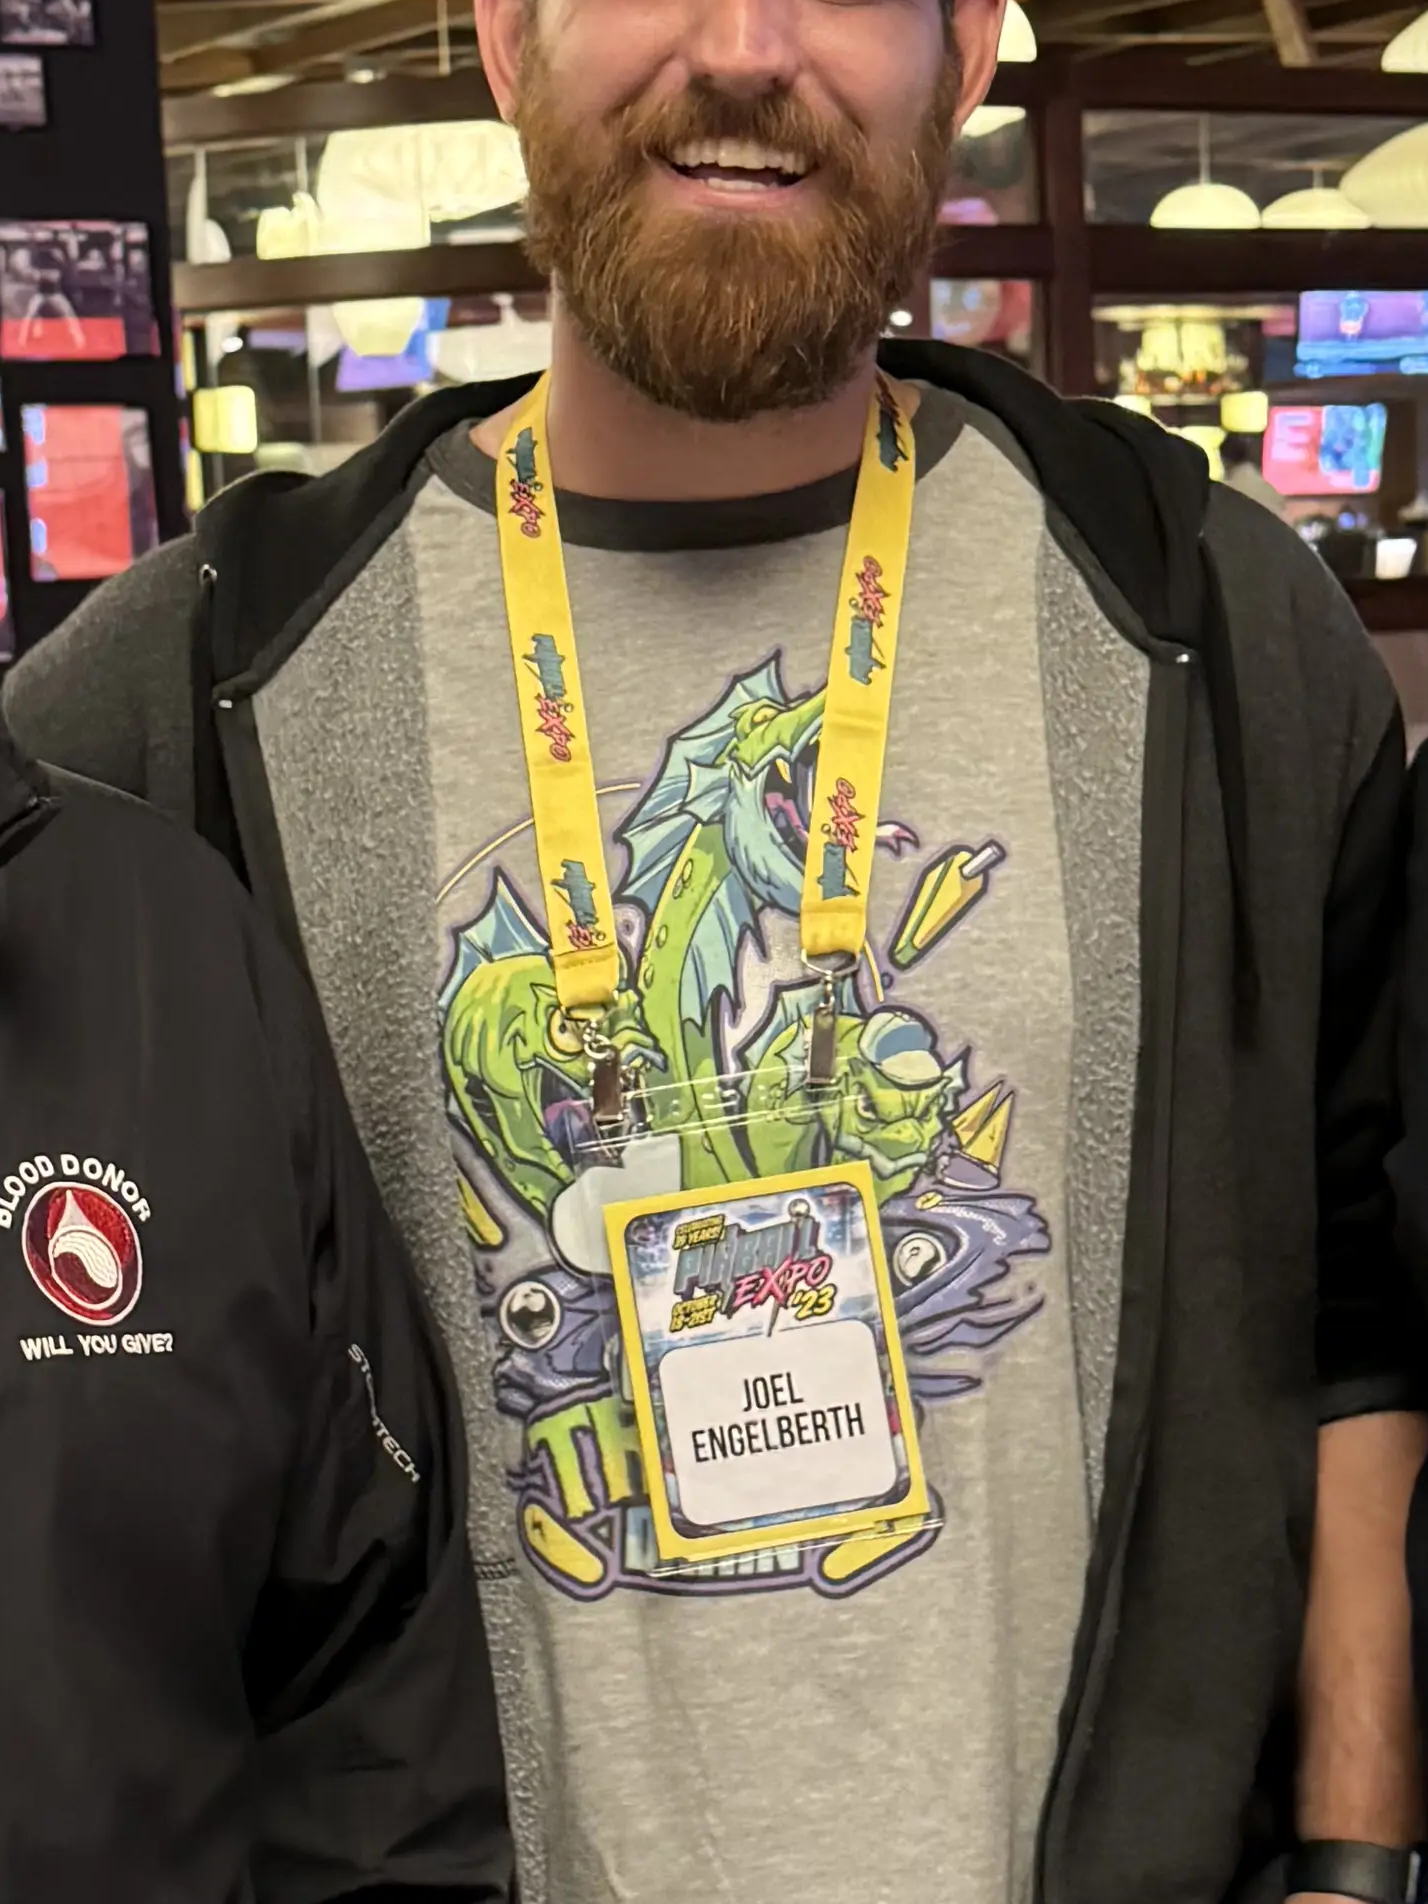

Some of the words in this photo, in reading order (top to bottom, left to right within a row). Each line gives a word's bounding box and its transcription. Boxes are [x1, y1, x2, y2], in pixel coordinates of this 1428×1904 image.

[535, 692, 572, 763] EXPO
[61, 1154, 151, 1222] DONOR
[732, 1253, 833, 1309] EXPO
[791, 1283, 838, 1320] '23
[20, 1335, 74, 1361] WILL
[78, 1334, 117, 1356] YOU
[122, 1332, 173, 1355] GIVE?
[348, 1343, 420, 1483] STTECH
[743, 1372, 803, 1412] JOEL
[692, 1403, 865, 1463] ENGELBERTH
